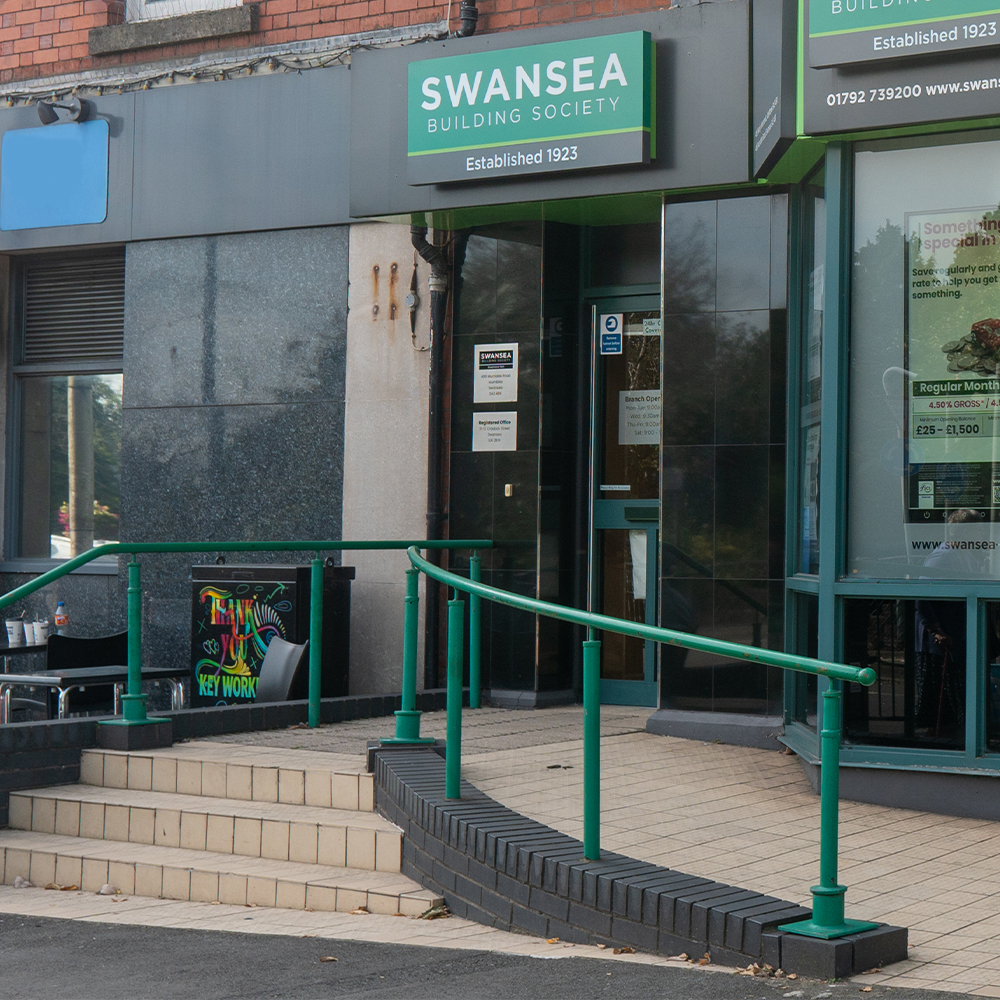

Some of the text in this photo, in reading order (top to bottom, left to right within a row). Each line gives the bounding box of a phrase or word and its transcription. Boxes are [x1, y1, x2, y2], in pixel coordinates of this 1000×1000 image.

[873, 21, 997, 50] Established 1923
[421, 52, 628, 111] SWANSEA
[826, 90, 866, 106] 01792
[869, 85, 922, 103] 739200
[428, 96, 620, 133] BUILDING SOCIETY
[466, 146, 578, 172] Established 1923
[924, 233, 979, 252] special
[981, 232, 996, 246] in
[912, 267, 934, 277] Save
[934, 263, 976, 276] regularly
[978, 262, 996, 272] and
[912, 278, 931, 288] rate
[932, 278, 942, 287] to
[964, 277, 981, 288] you
[983, 275, 998, 286] get
[912, 289, 963, 300] something.
[920, 382, 962, 395] Regular
[929, 400, 952, 409] 4.50%
[916, 425, 936, 435] £25
[946, 424, 979, 436] £1,500
[202, 590, 255, 626] THANK
[221, 634, 248, 660] YOU
[199, 673, 259, 698] KEY WORK
